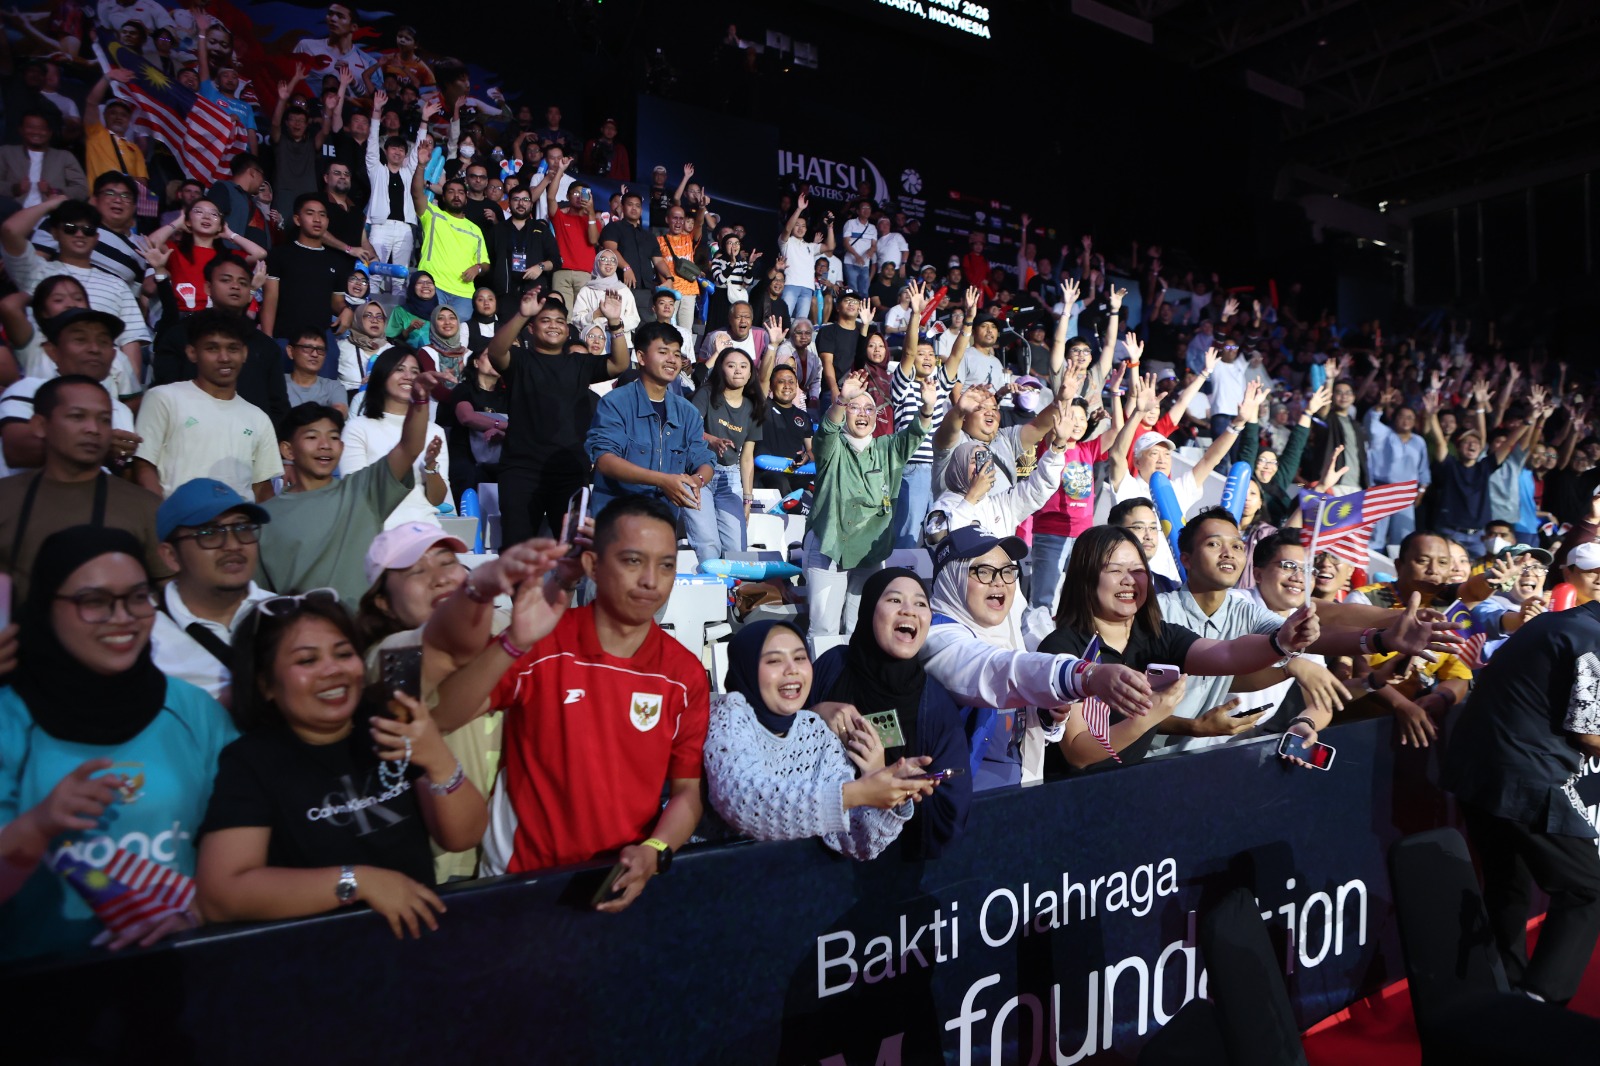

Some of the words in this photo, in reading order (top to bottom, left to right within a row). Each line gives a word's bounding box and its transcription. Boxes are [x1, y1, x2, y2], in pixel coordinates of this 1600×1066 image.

[928, 7, 991, 39] INDONESIA
[963, 1, 989, 21] 2026
[808, 184, 843, 201] ASTERS
[816, 901, 960, 999] Bakti
[979, 857, 1179, 948] Olahraga
[944, 877, 1369, 1066] foundion
